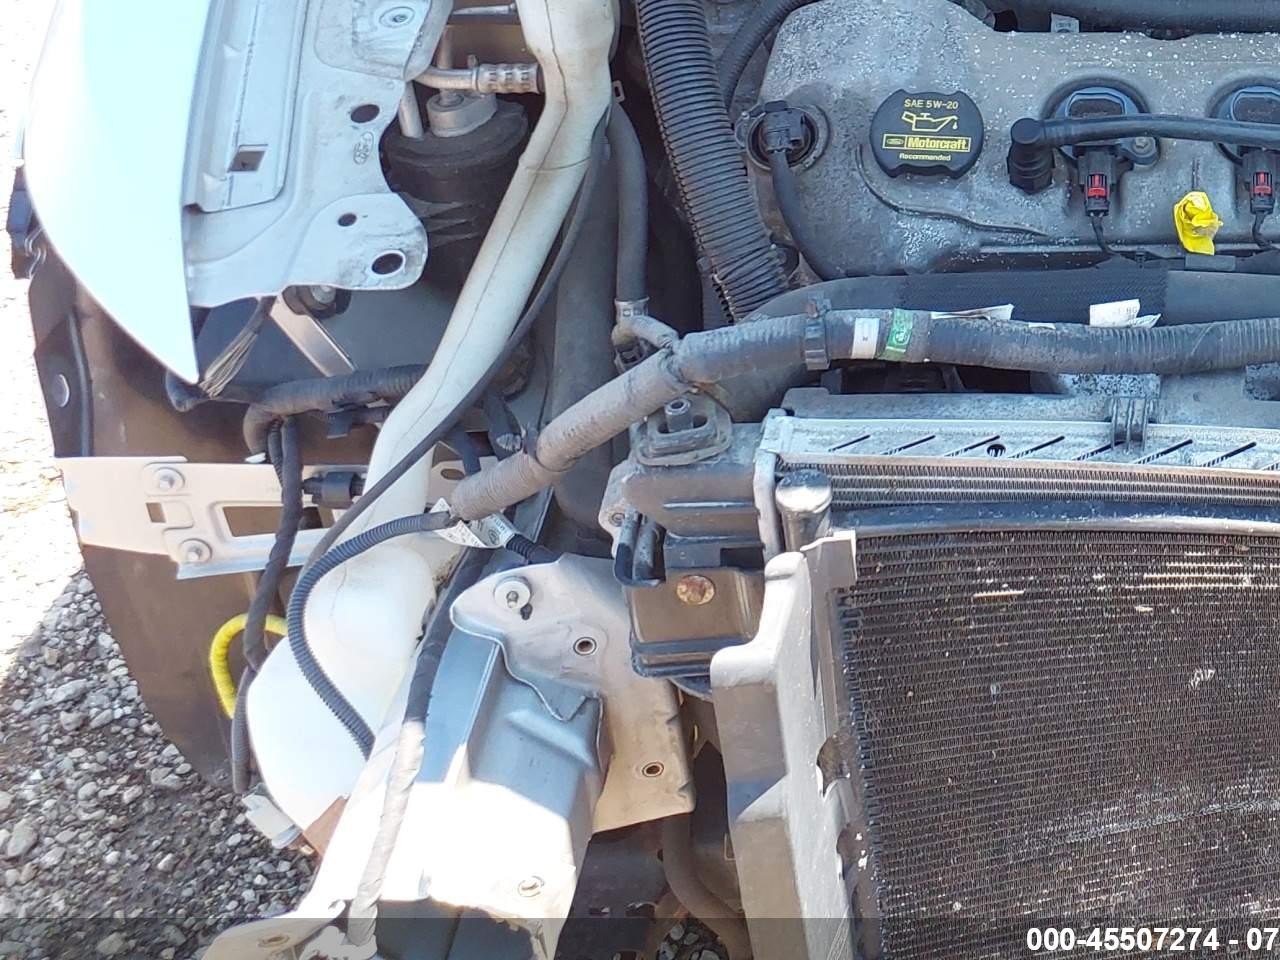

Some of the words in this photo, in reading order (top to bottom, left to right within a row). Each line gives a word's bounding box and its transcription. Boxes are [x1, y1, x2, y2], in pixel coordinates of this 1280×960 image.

[904, 98, 924, 109] SAE
[926, 100, 959, 110] 5W-20
[907, 137, 968, 150] Motorcraft
[899, 153, 952, 161] Recommended
